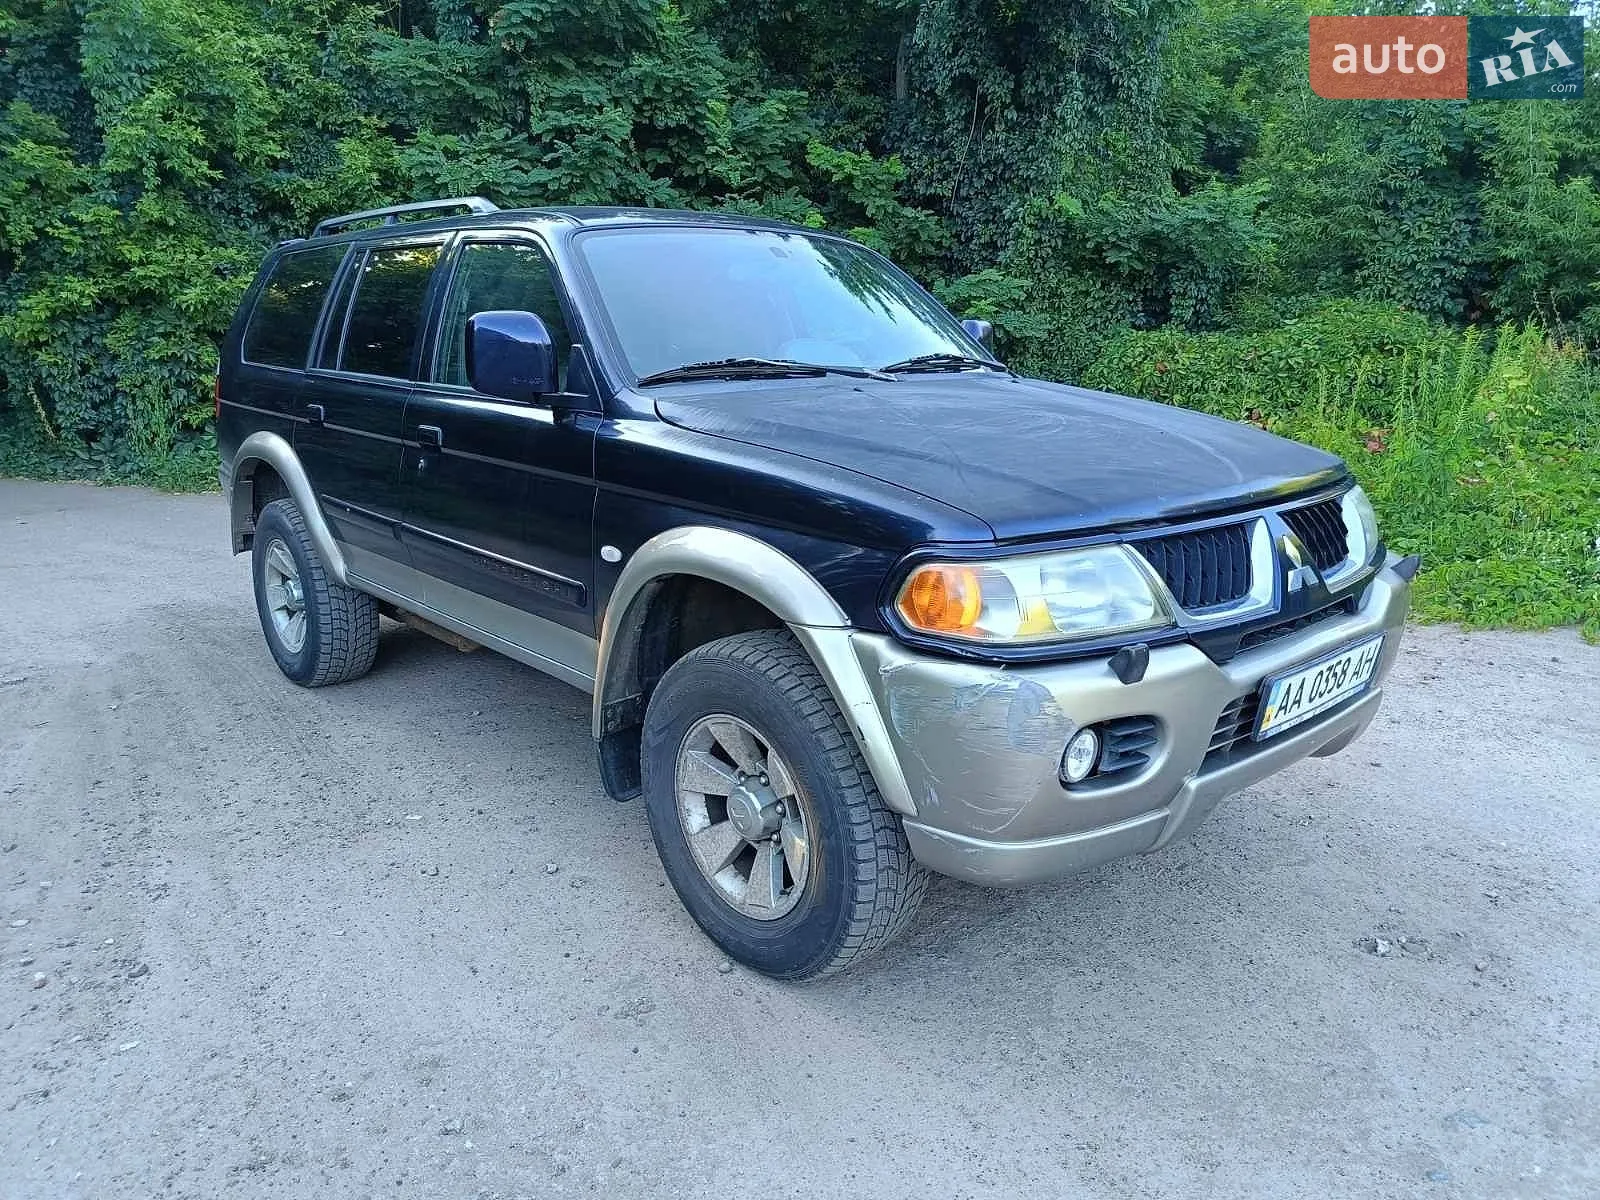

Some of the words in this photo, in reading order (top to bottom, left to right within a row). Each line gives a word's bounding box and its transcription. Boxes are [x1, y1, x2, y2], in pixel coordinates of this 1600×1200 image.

[1274, 677, 1306, 719] AA
[1309, 657, 1351, 703] 0358
[1350, 644, 1378, 684] AH
